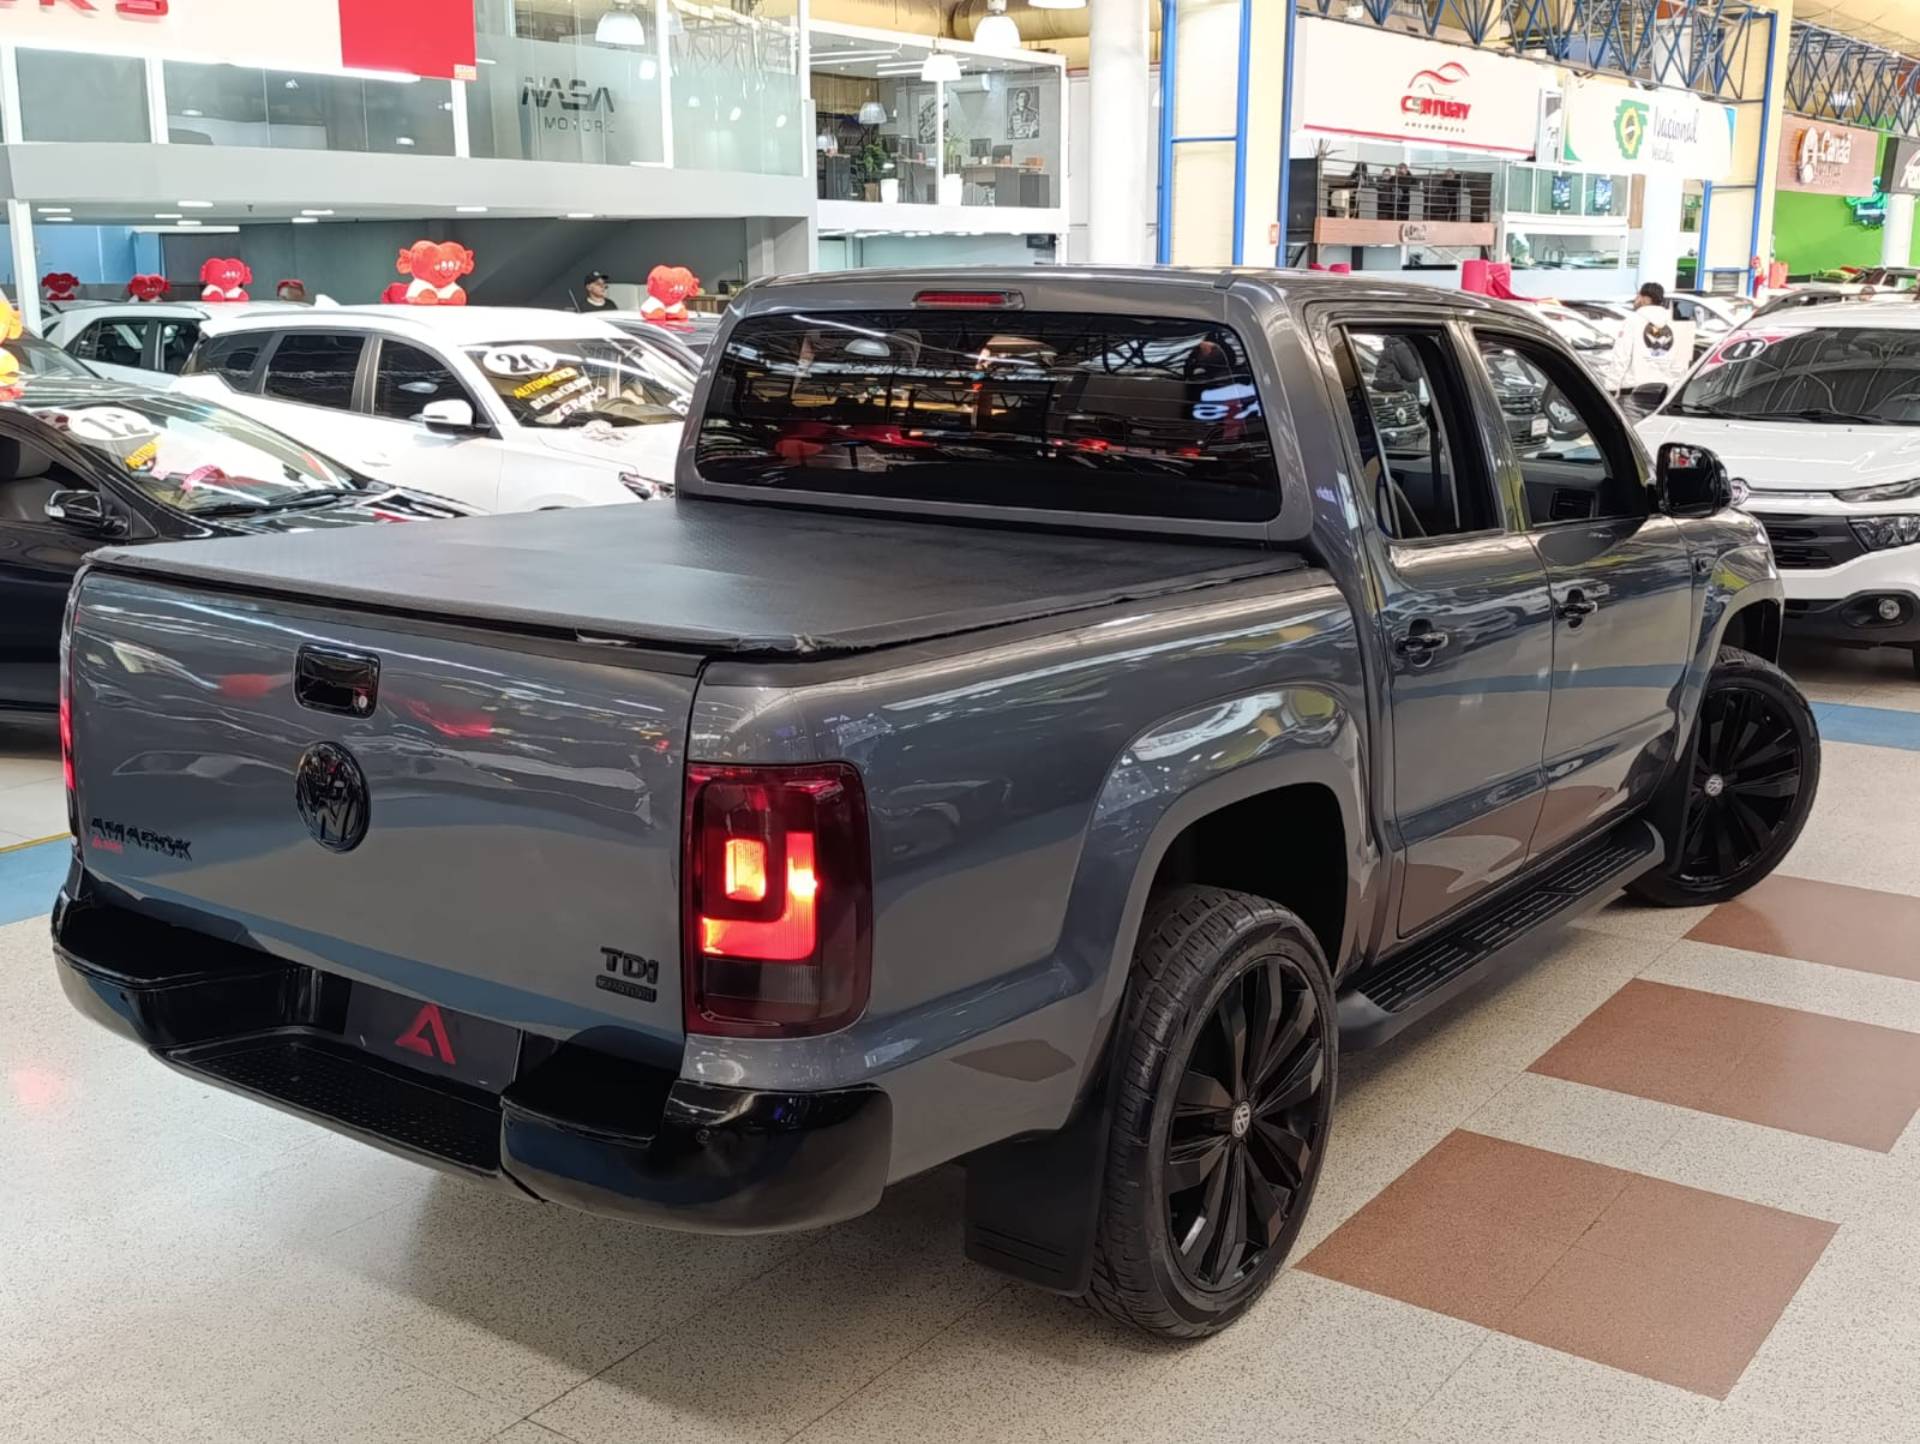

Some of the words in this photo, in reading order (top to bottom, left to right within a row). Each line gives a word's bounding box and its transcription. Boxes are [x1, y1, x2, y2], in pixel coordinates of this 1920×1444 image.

[522, 77, 614, 113] NASA
[496, 352, 549, 374] 26
[1733, 342, 1763, 357] 17
[91, 817, 193, 862] AMAROK
[600, 946, 659, 985] TDI
